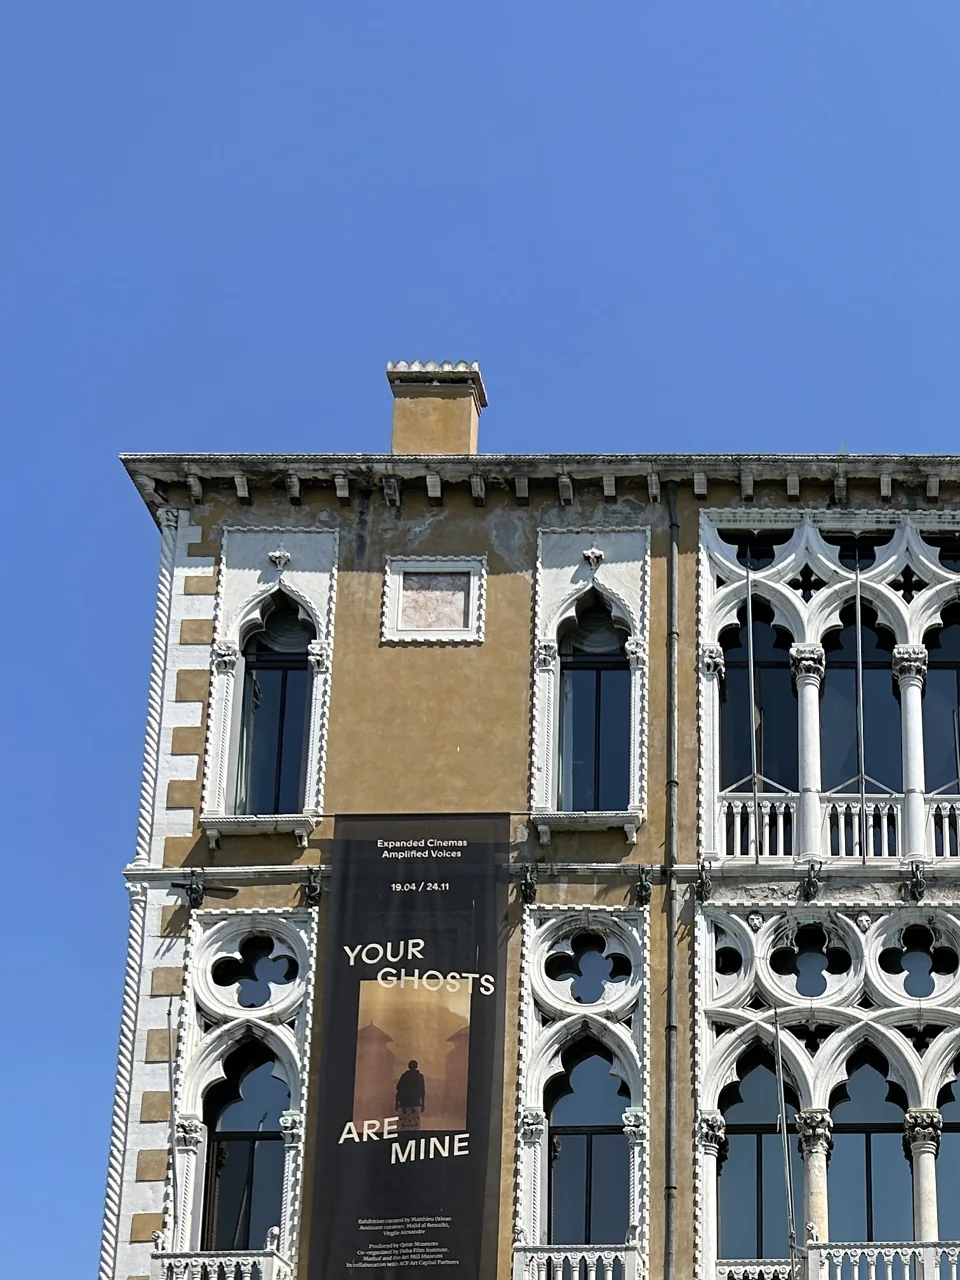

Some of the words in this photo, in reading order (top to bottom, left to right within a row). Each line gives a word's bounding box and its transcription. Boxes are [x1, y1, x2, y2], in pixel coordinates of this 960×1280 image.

[377, 839, 424, 848] Expanded
[427, 839, 468, 847] Cinemas
[382, 850, 428, 859] Amplified
[431, 850, 462, 858] Voices
[391, 883, 416, 892] 19.04
[426, 882, 449, 891] 24.11
[343, 939, 425, 966] YOUR
[377, 967, 495, 996] GHOSTS
[338, 1116, 399, 1144] ARE
[391, 1133, 470, 1164] MINE
